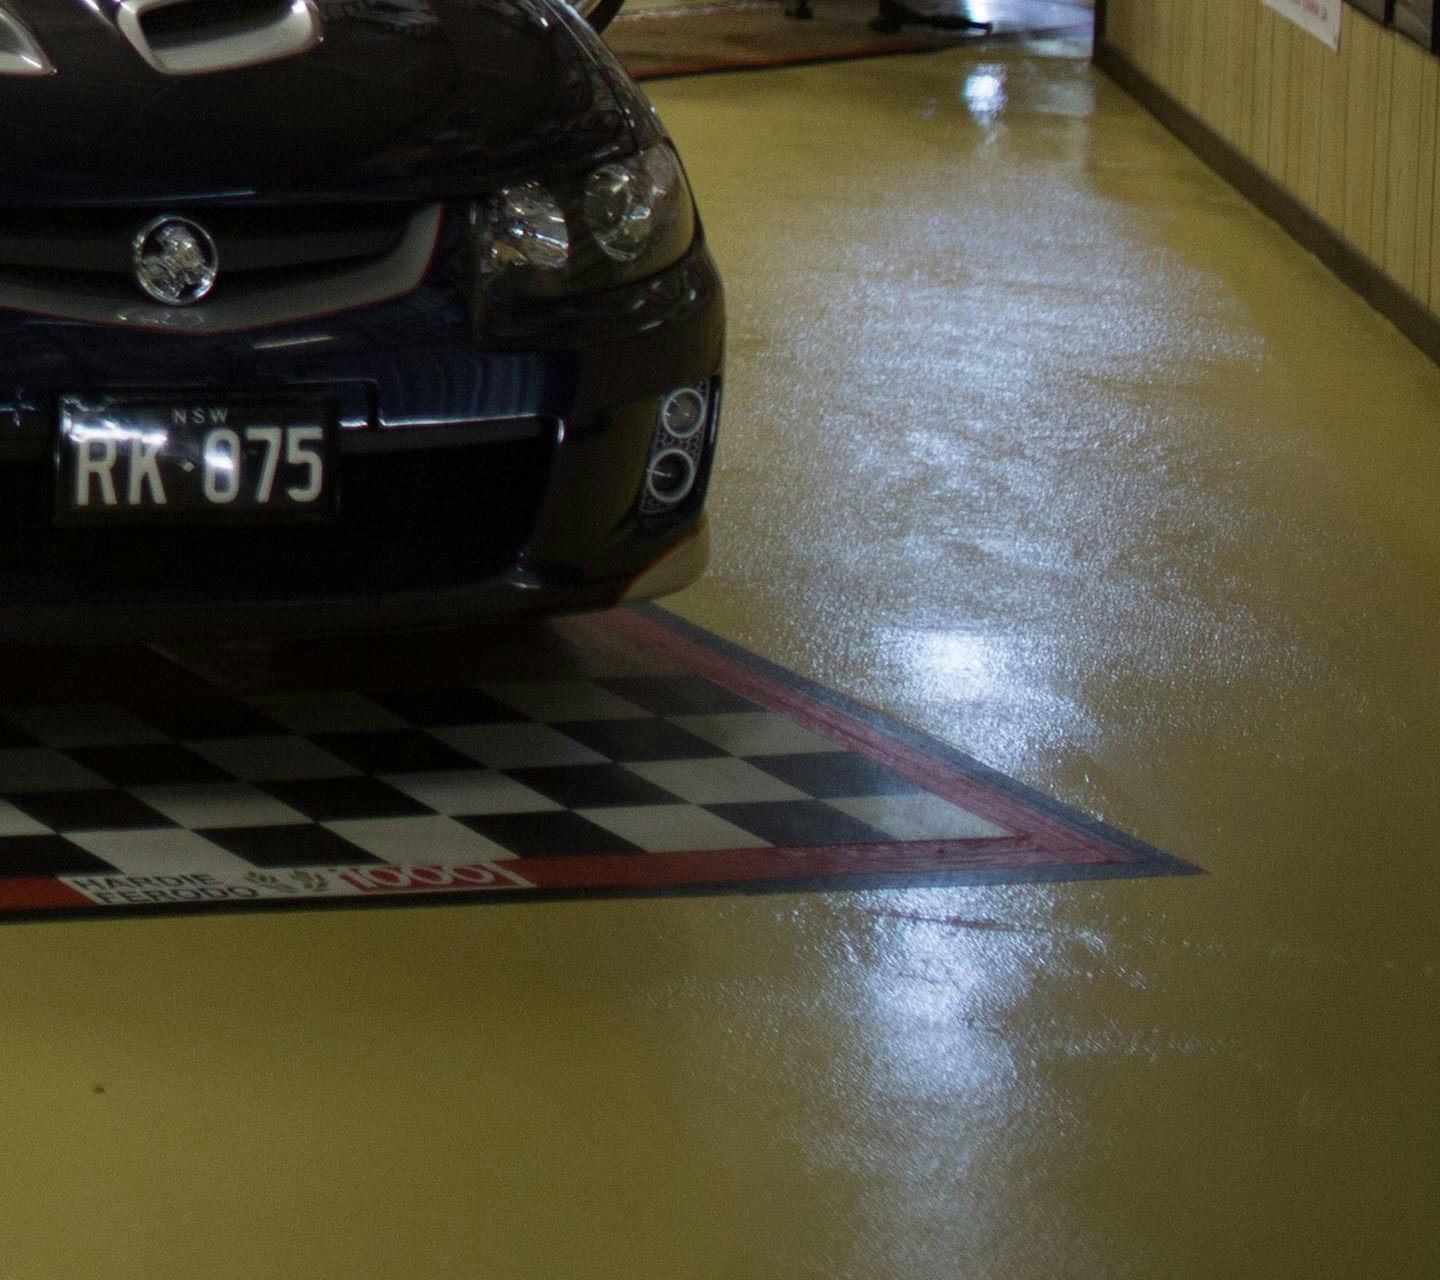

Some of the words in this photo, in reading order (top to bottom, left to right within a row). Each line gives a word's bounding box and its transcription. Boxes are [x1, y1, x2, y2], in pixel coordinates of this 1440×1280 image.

[171, 407, 229, 425] NSW
[72, 873, 222, 891] HARDIE
[340, 864, 498, 893] 1000
[97, 884, 263, 905] FERODO
